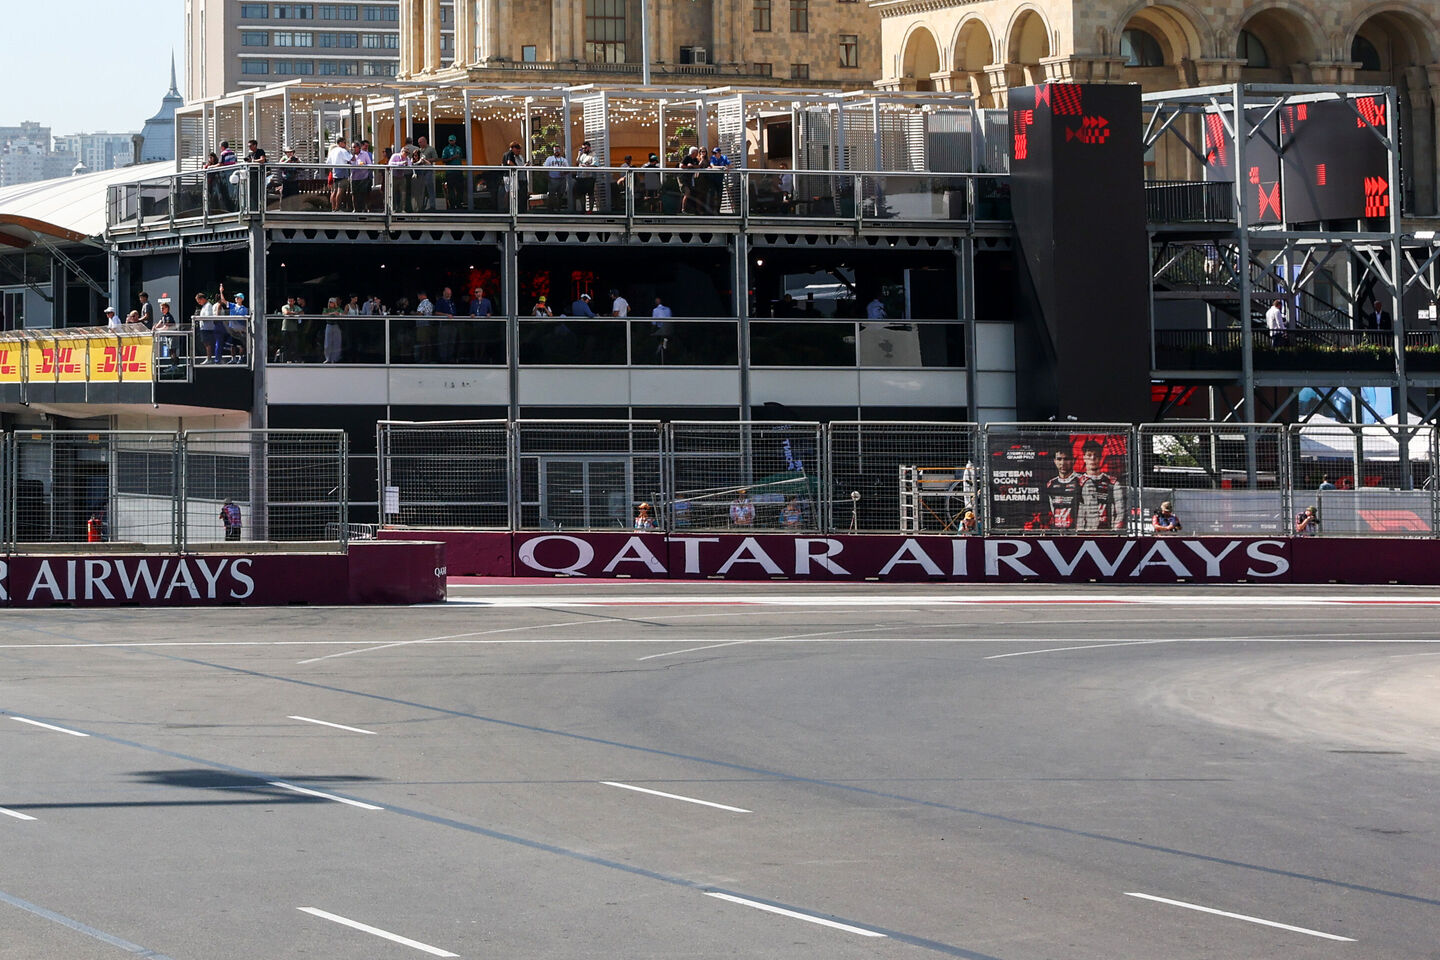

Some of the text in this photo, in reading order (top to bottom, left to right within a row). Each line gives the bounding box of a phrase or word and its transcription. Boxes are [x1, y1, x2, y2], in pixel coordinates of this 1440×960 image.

[42, 348, 76, 374] DHL
[103, 345, 140, 373] DHL
[993, 470, 1033, 478] ESTEBAN
[518, 535, 1291, 578] QATAR AIRWAYS
[26, 558, 255, 600] AIRWAYS
